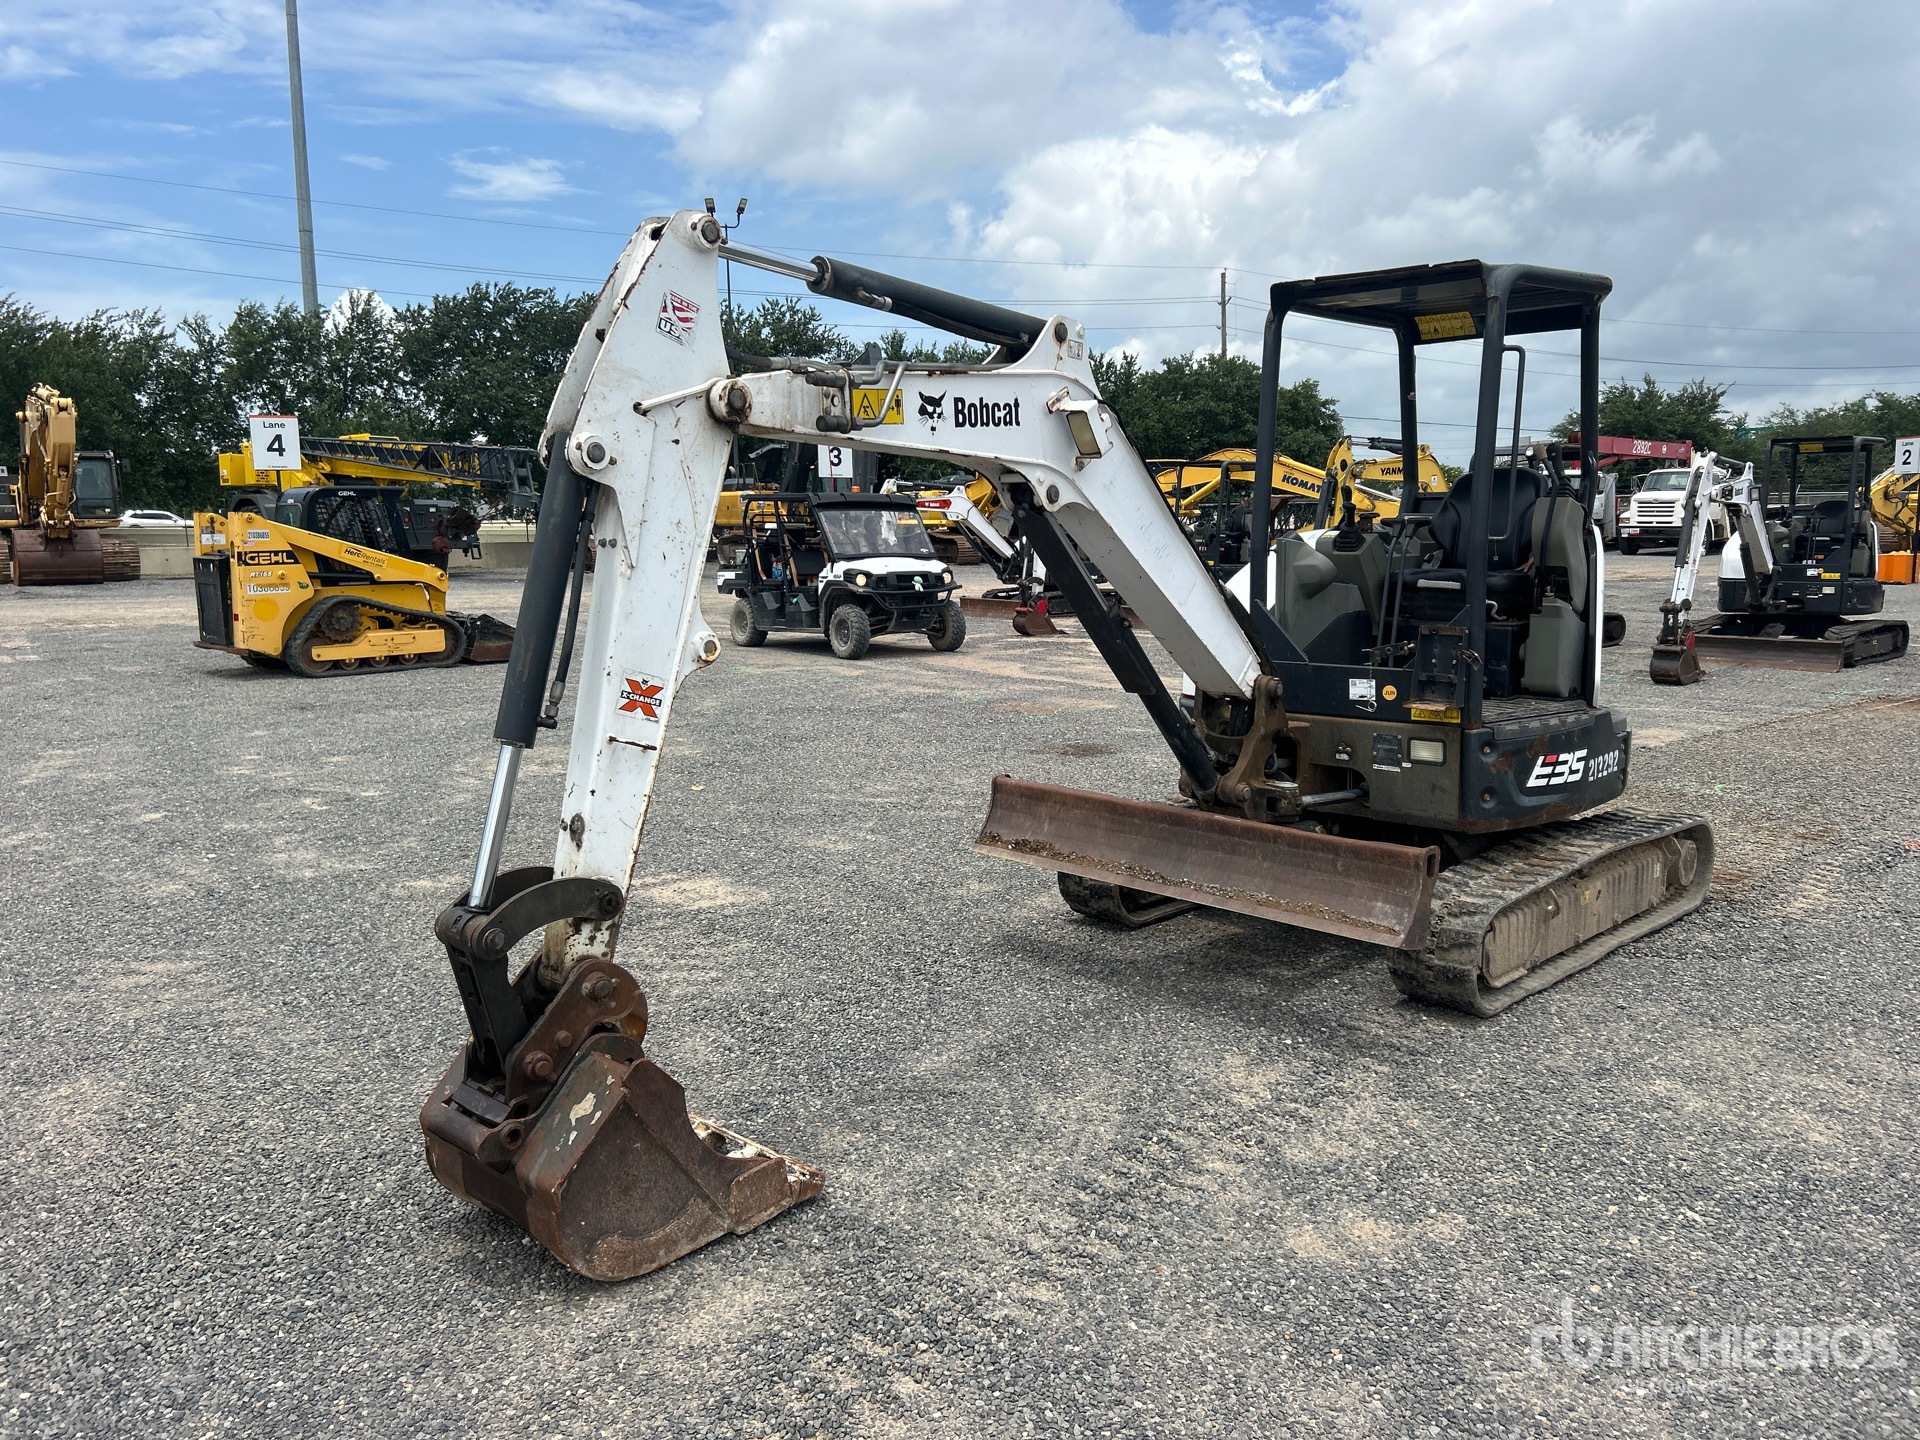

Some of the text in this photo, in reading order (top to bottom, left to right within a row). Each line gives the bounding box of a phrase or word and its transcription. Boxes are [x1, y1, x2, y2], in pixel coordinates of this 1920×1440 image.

[953, 396, 1021, 428] Bobcat
[262, 421, 286, 429] Lane
[266, 433, 286, 457] 4
[829, 446, 842, 467] 3
[1902, 449, 1912, 466] 2
[1380, 467, 1404, 476] YANM
[1281, 473, 1322, 494] KOMAT
[245, 551, 295, 565] GEHL
[344, 547, 386, 565] HercRentals
[621, 691, 661, 706] X-CHANGE
[1526, 748, 1619, 788] E35 212292
